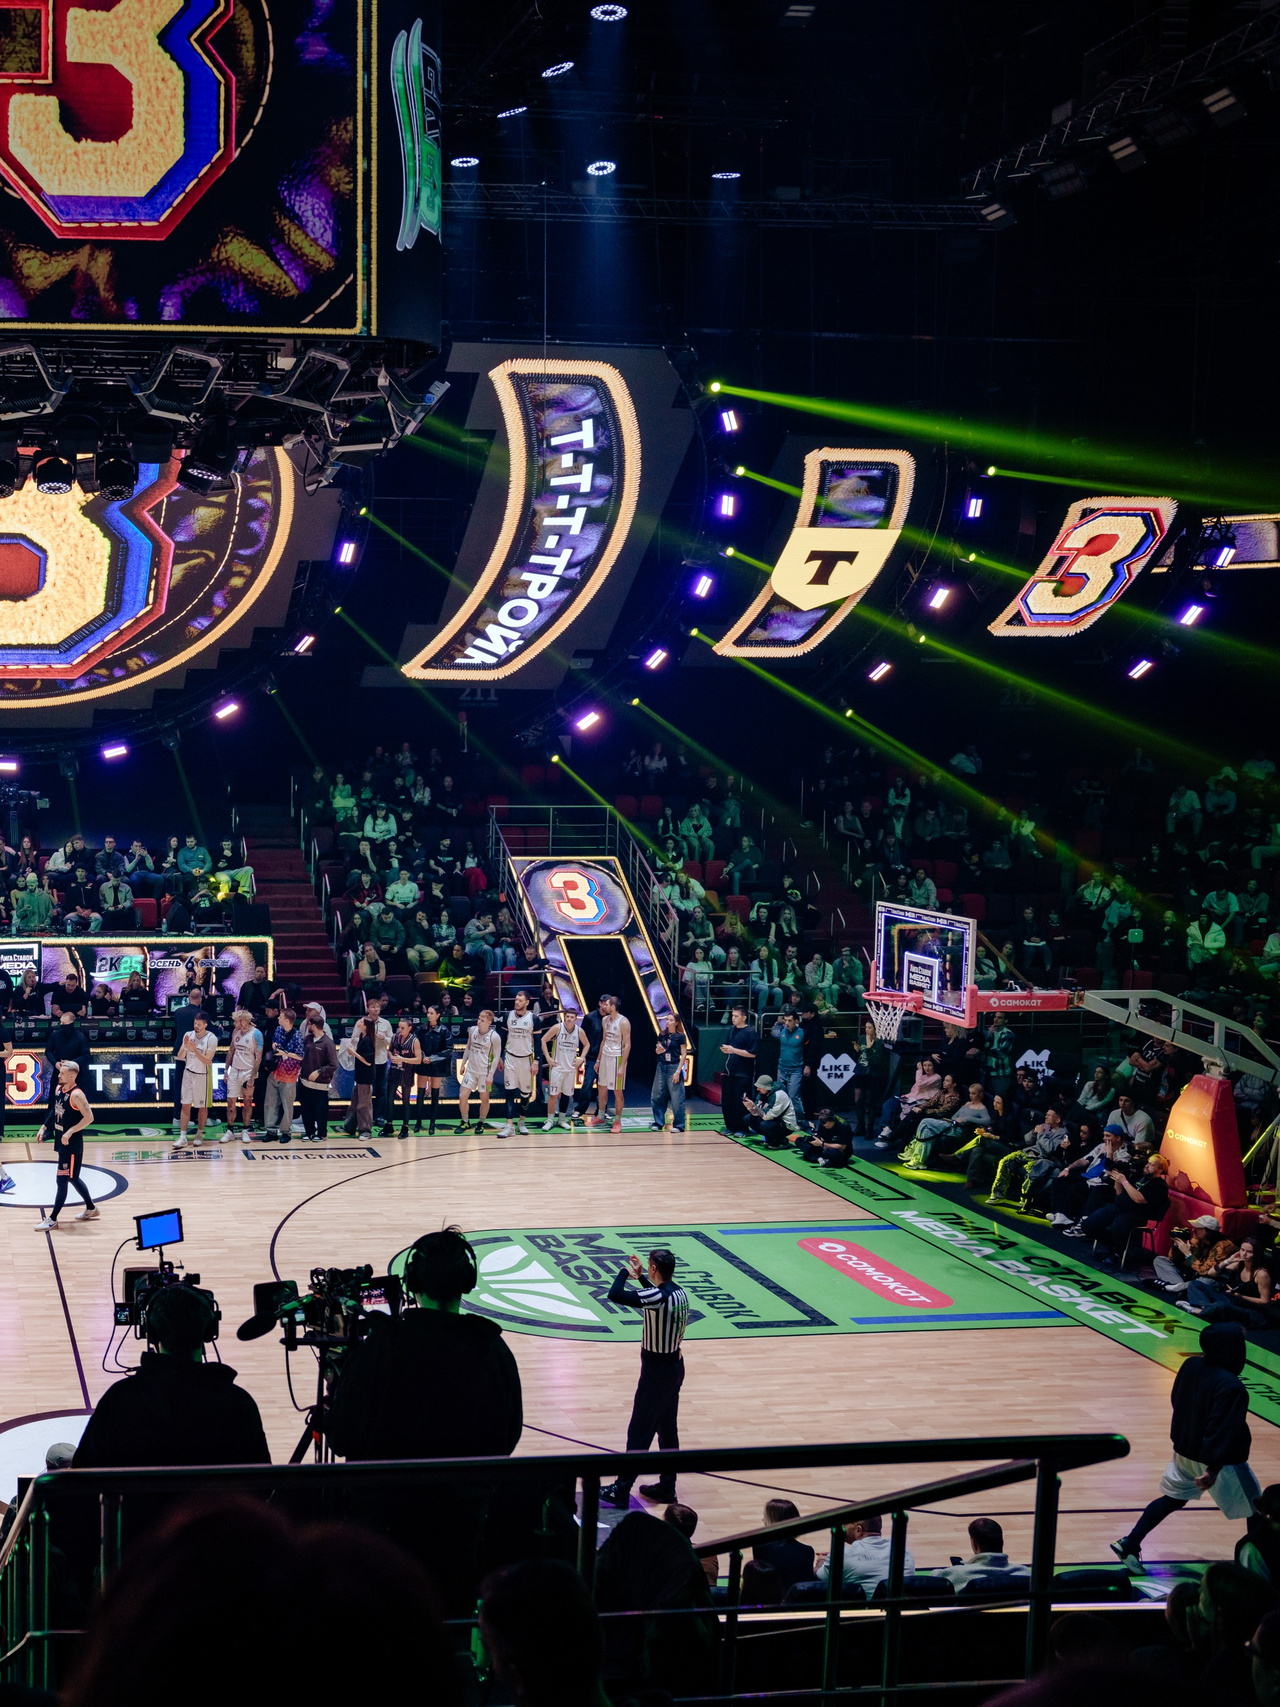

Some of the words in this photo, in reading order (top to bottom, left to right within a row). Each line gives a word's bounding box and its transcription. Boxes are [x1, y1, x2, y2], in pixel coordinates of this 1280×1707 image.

[1018, 507, 1167, 626] 3
[547, 868, 609, 926] 3
[97, 955, 144, 973] 2K25
[149, 959, 181, 968] ОСЕНЬ
[185, 955, 195, 970] 6
[5, 1052, 43, 1106] 3
[822, 1064, 850, 1072] LIKE
[835, 1253, 933, 1306] самокат
[891, 1211, 995, 1259] MEDIA
[987, 1259, 1169, 1339] BASKET
[925, 1211, 1017, 1251] ЛИГА
[1022, 1255, 1200, 1336] СТАВОК
